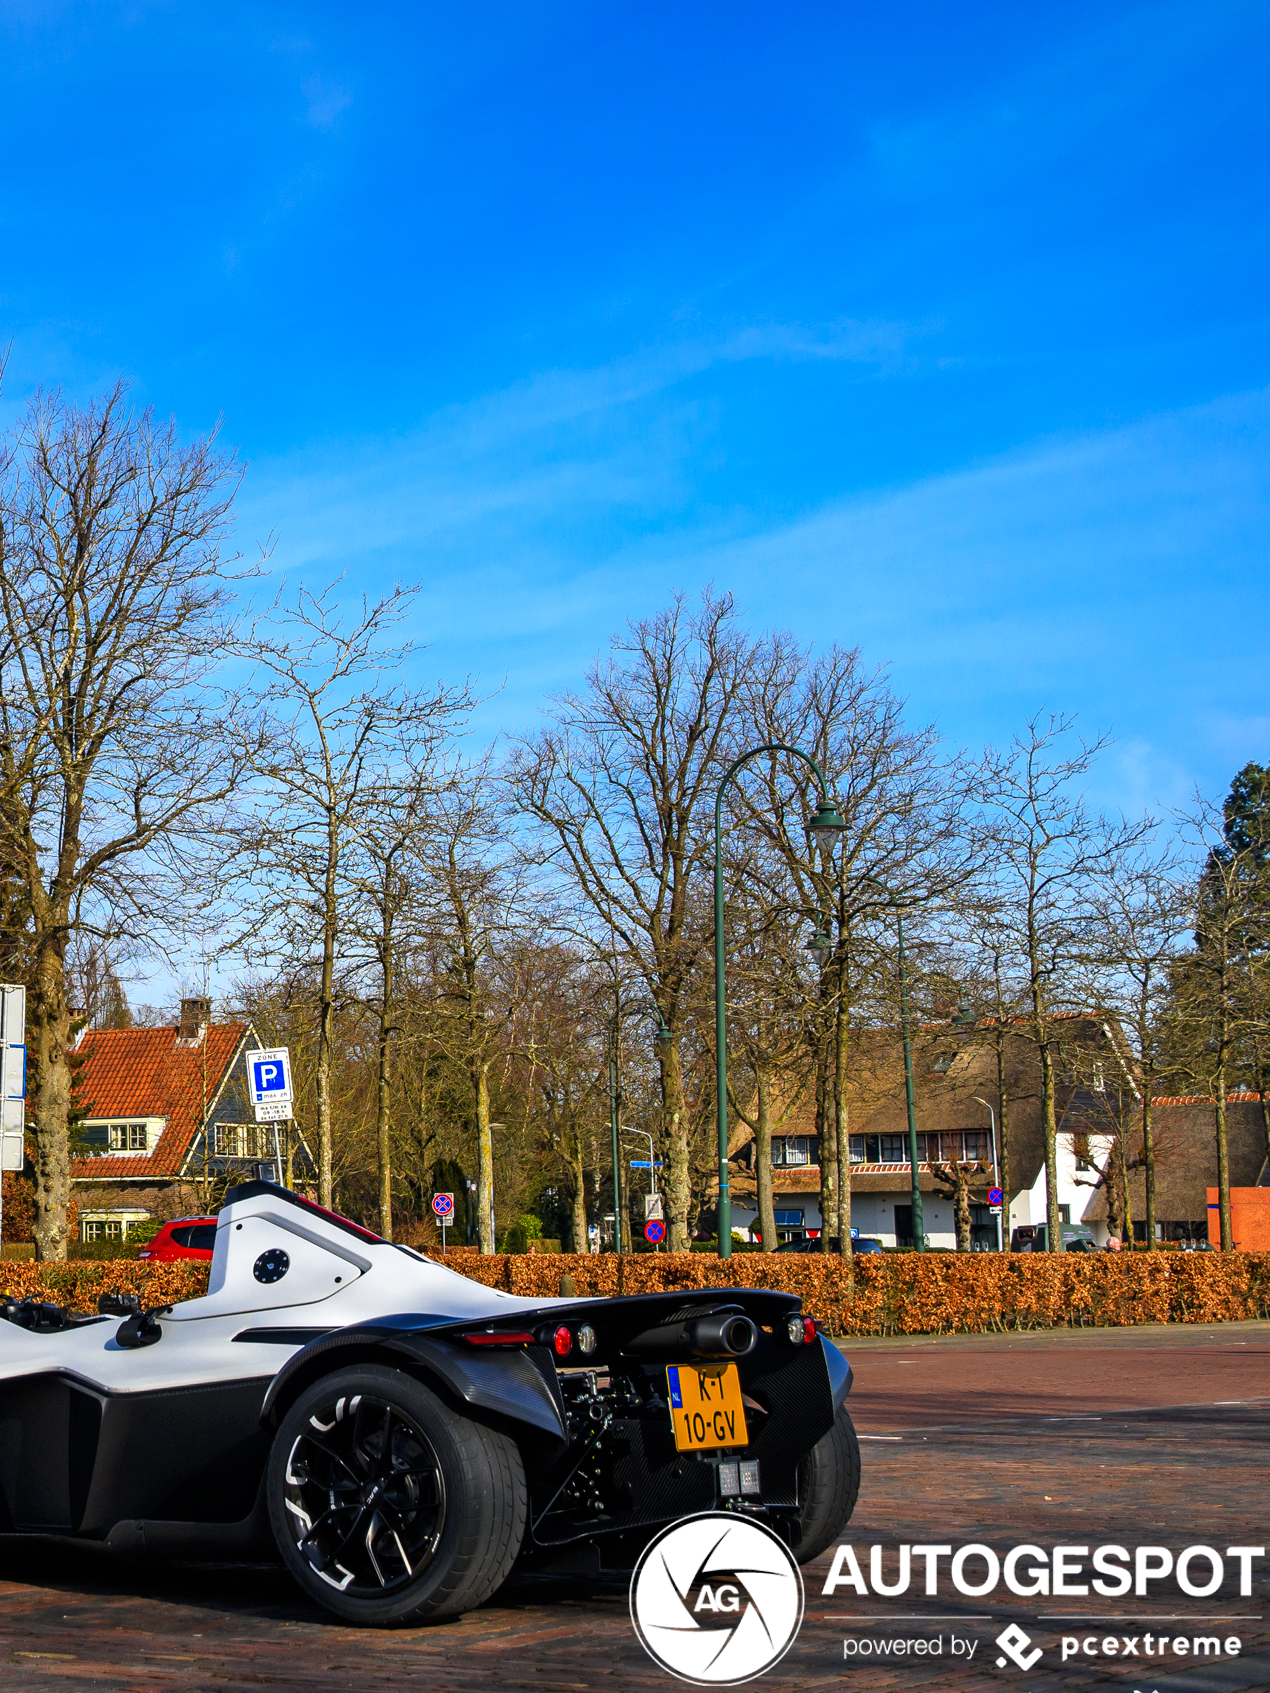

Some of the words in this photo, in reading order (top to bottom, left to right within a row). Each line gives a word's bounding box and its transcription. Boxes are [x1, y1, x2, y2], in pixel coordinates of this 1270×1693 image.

[257, 1053, 278, 1061] ZONE
[260, 1064, 278, 1088] P
[672, 1392, 681, 1402] NL
[697, 1370, 724, 1402] K-1
[684, 1410, 735, 1444] 10-GV
